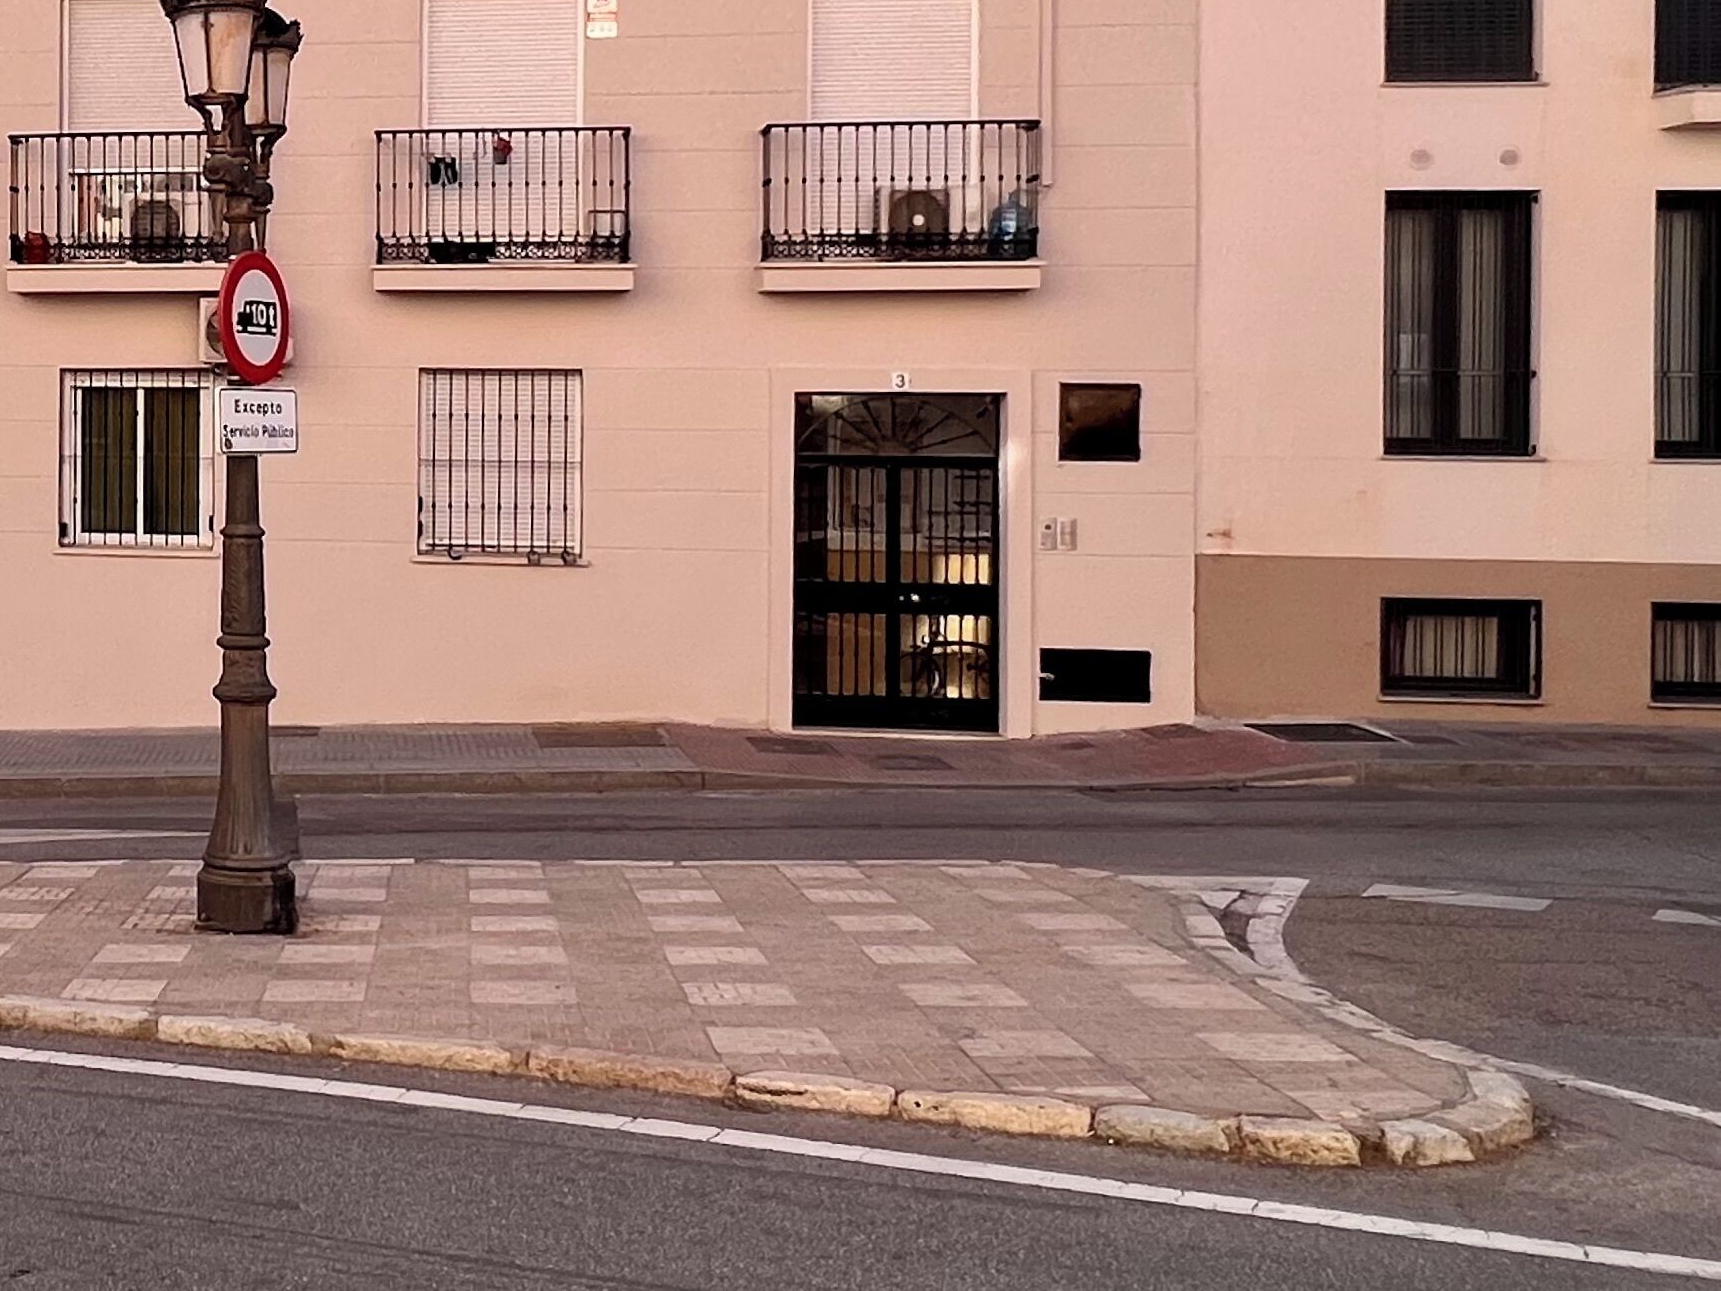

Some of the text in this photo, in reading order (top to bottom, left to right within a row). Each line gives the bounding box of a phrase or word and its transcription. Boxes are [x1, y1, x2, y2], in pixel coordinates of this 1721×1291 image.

[895, 374, 905, 389] 3
[234, 399, 282, 417] Excepto
[223, 424, 259, 438] Servicio
